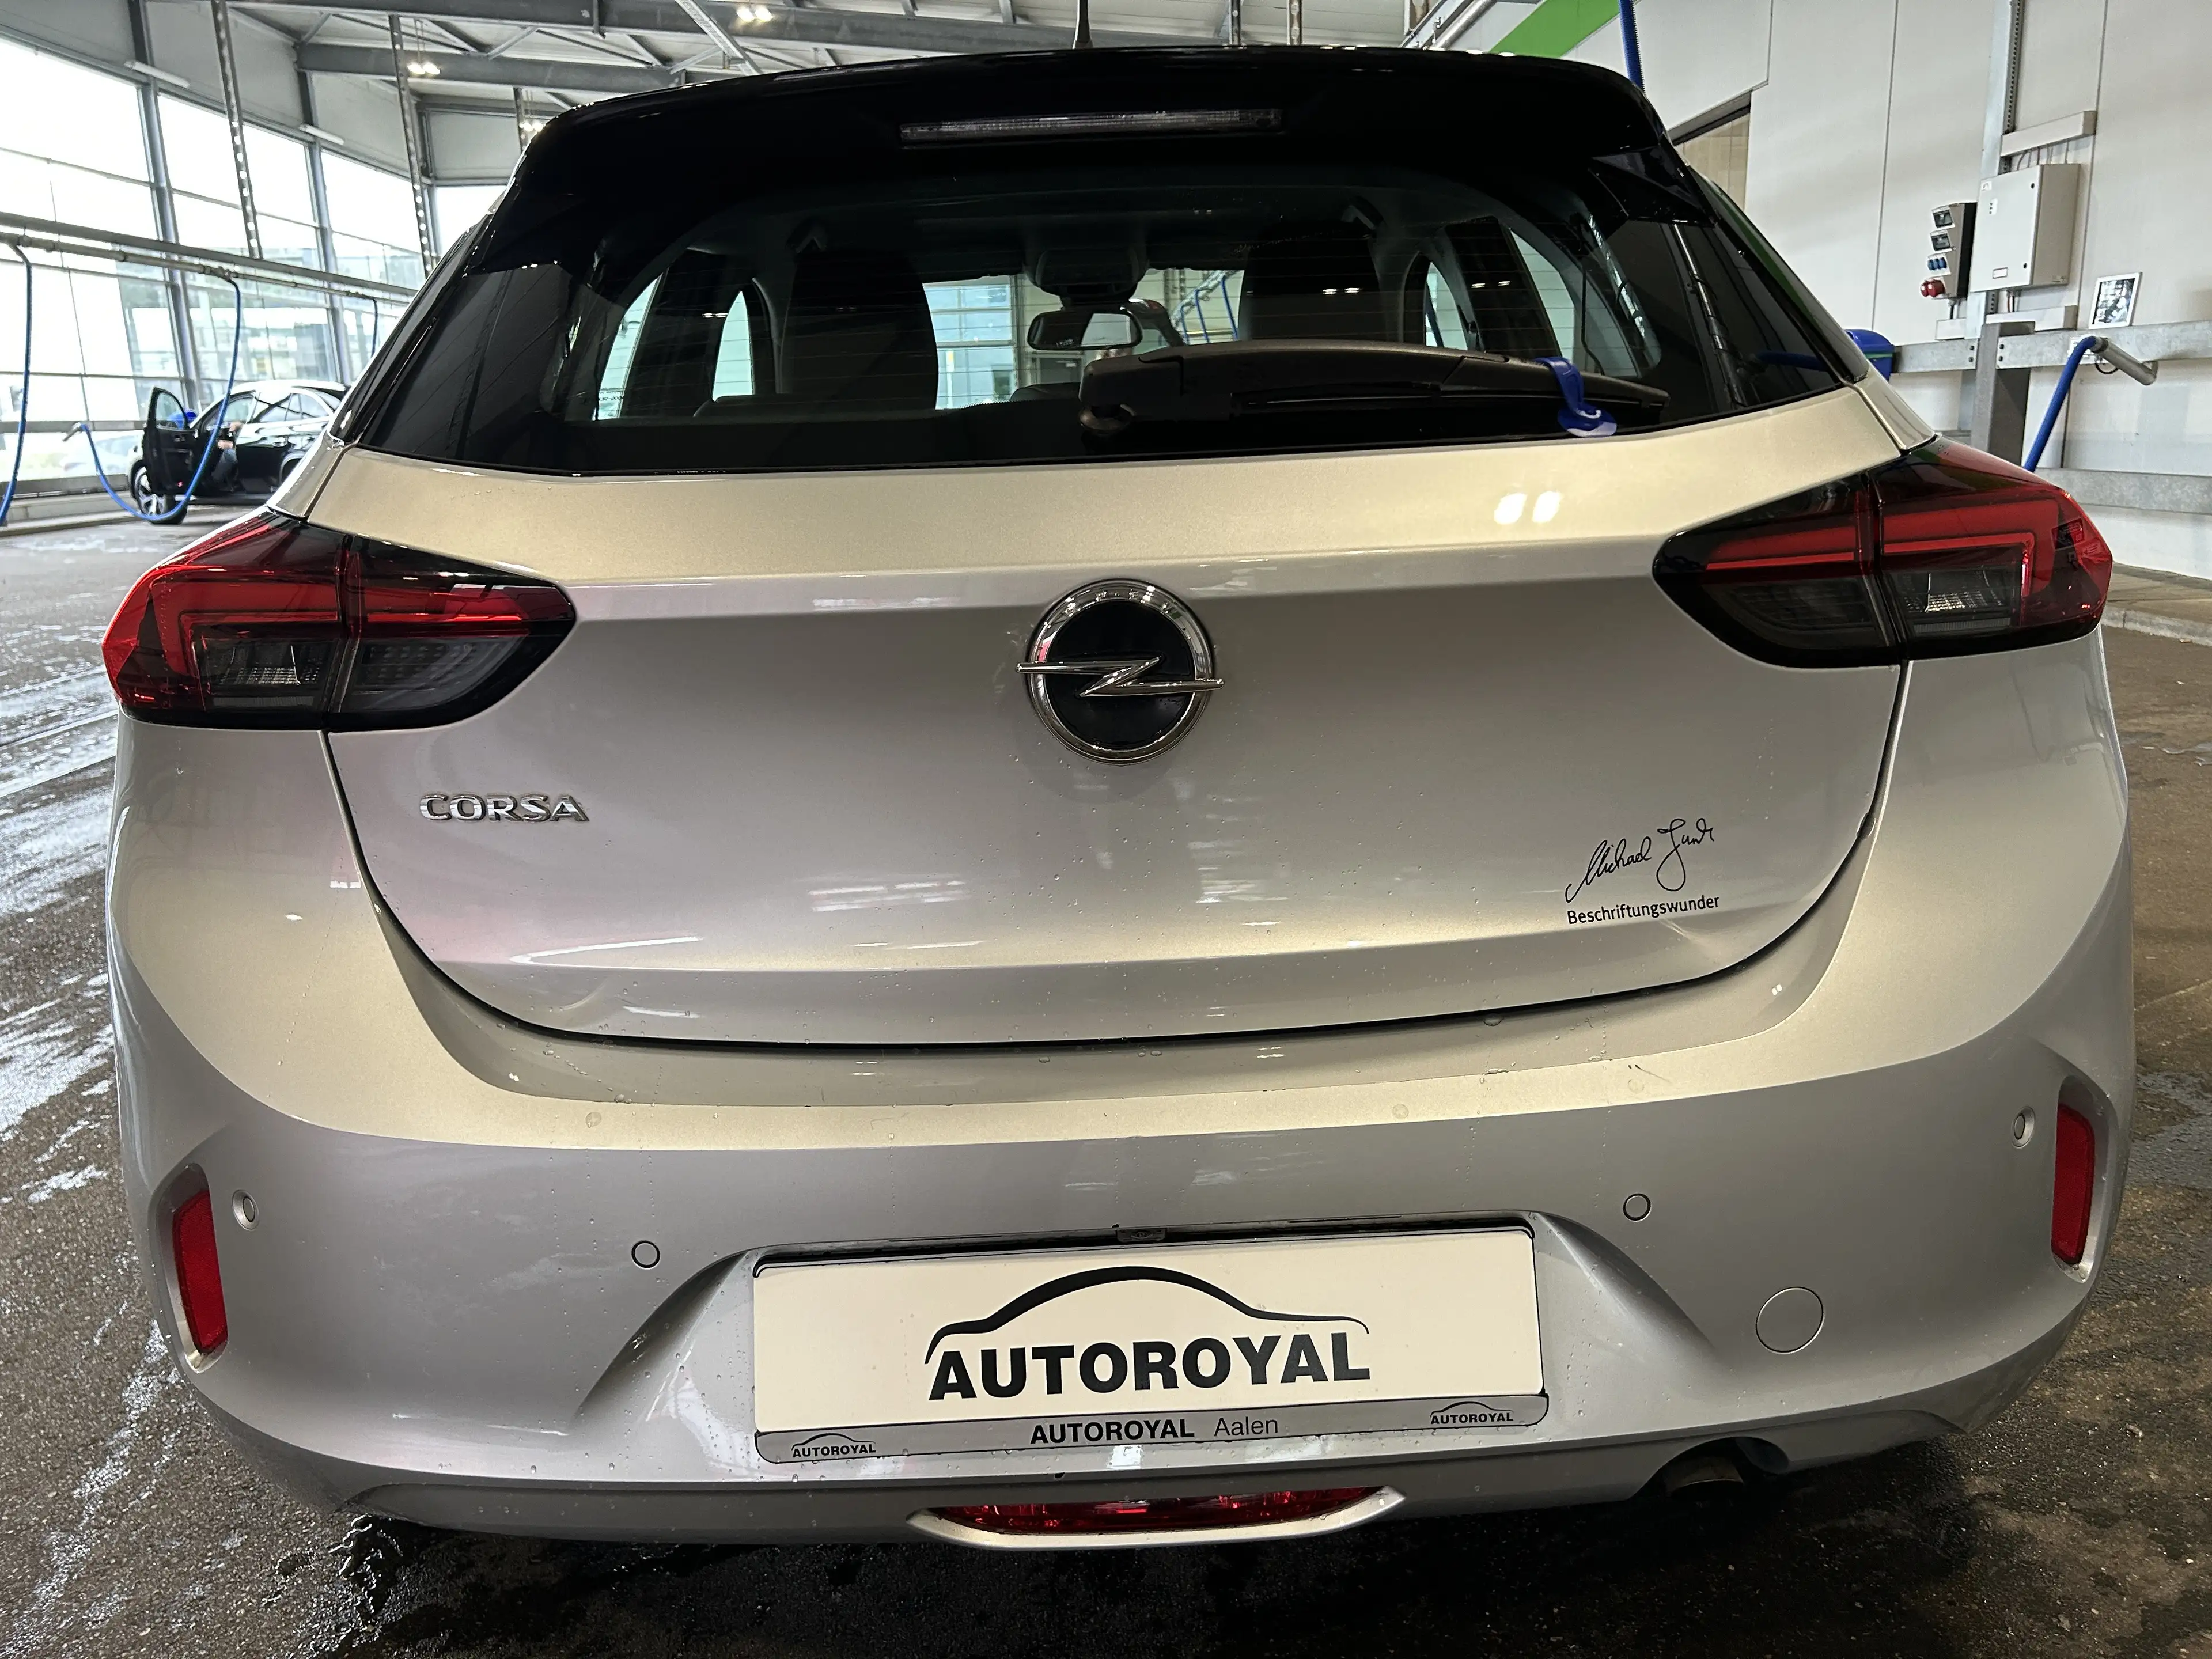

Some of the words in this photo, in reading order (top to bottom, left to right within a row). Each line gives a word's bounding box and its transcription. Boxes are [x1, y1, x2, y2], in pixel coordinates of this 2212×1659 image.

[419, 793, 590, 822] CORSA
[1565, 835, 1653, 903] Michael
[1567, 895, 1719, 925] Beschriftungswunder
[928, 1332, 1370, 1401] AUTOROYAL
[1030, 1418, 1195, 1445] AUTOROYAL
[1214, 1416, 1278, 1437] Aalen
[1430, 1412, 1514, 1425] AUTOROYAL
[792, 1444, 877, 1458] AUTOROYAL
